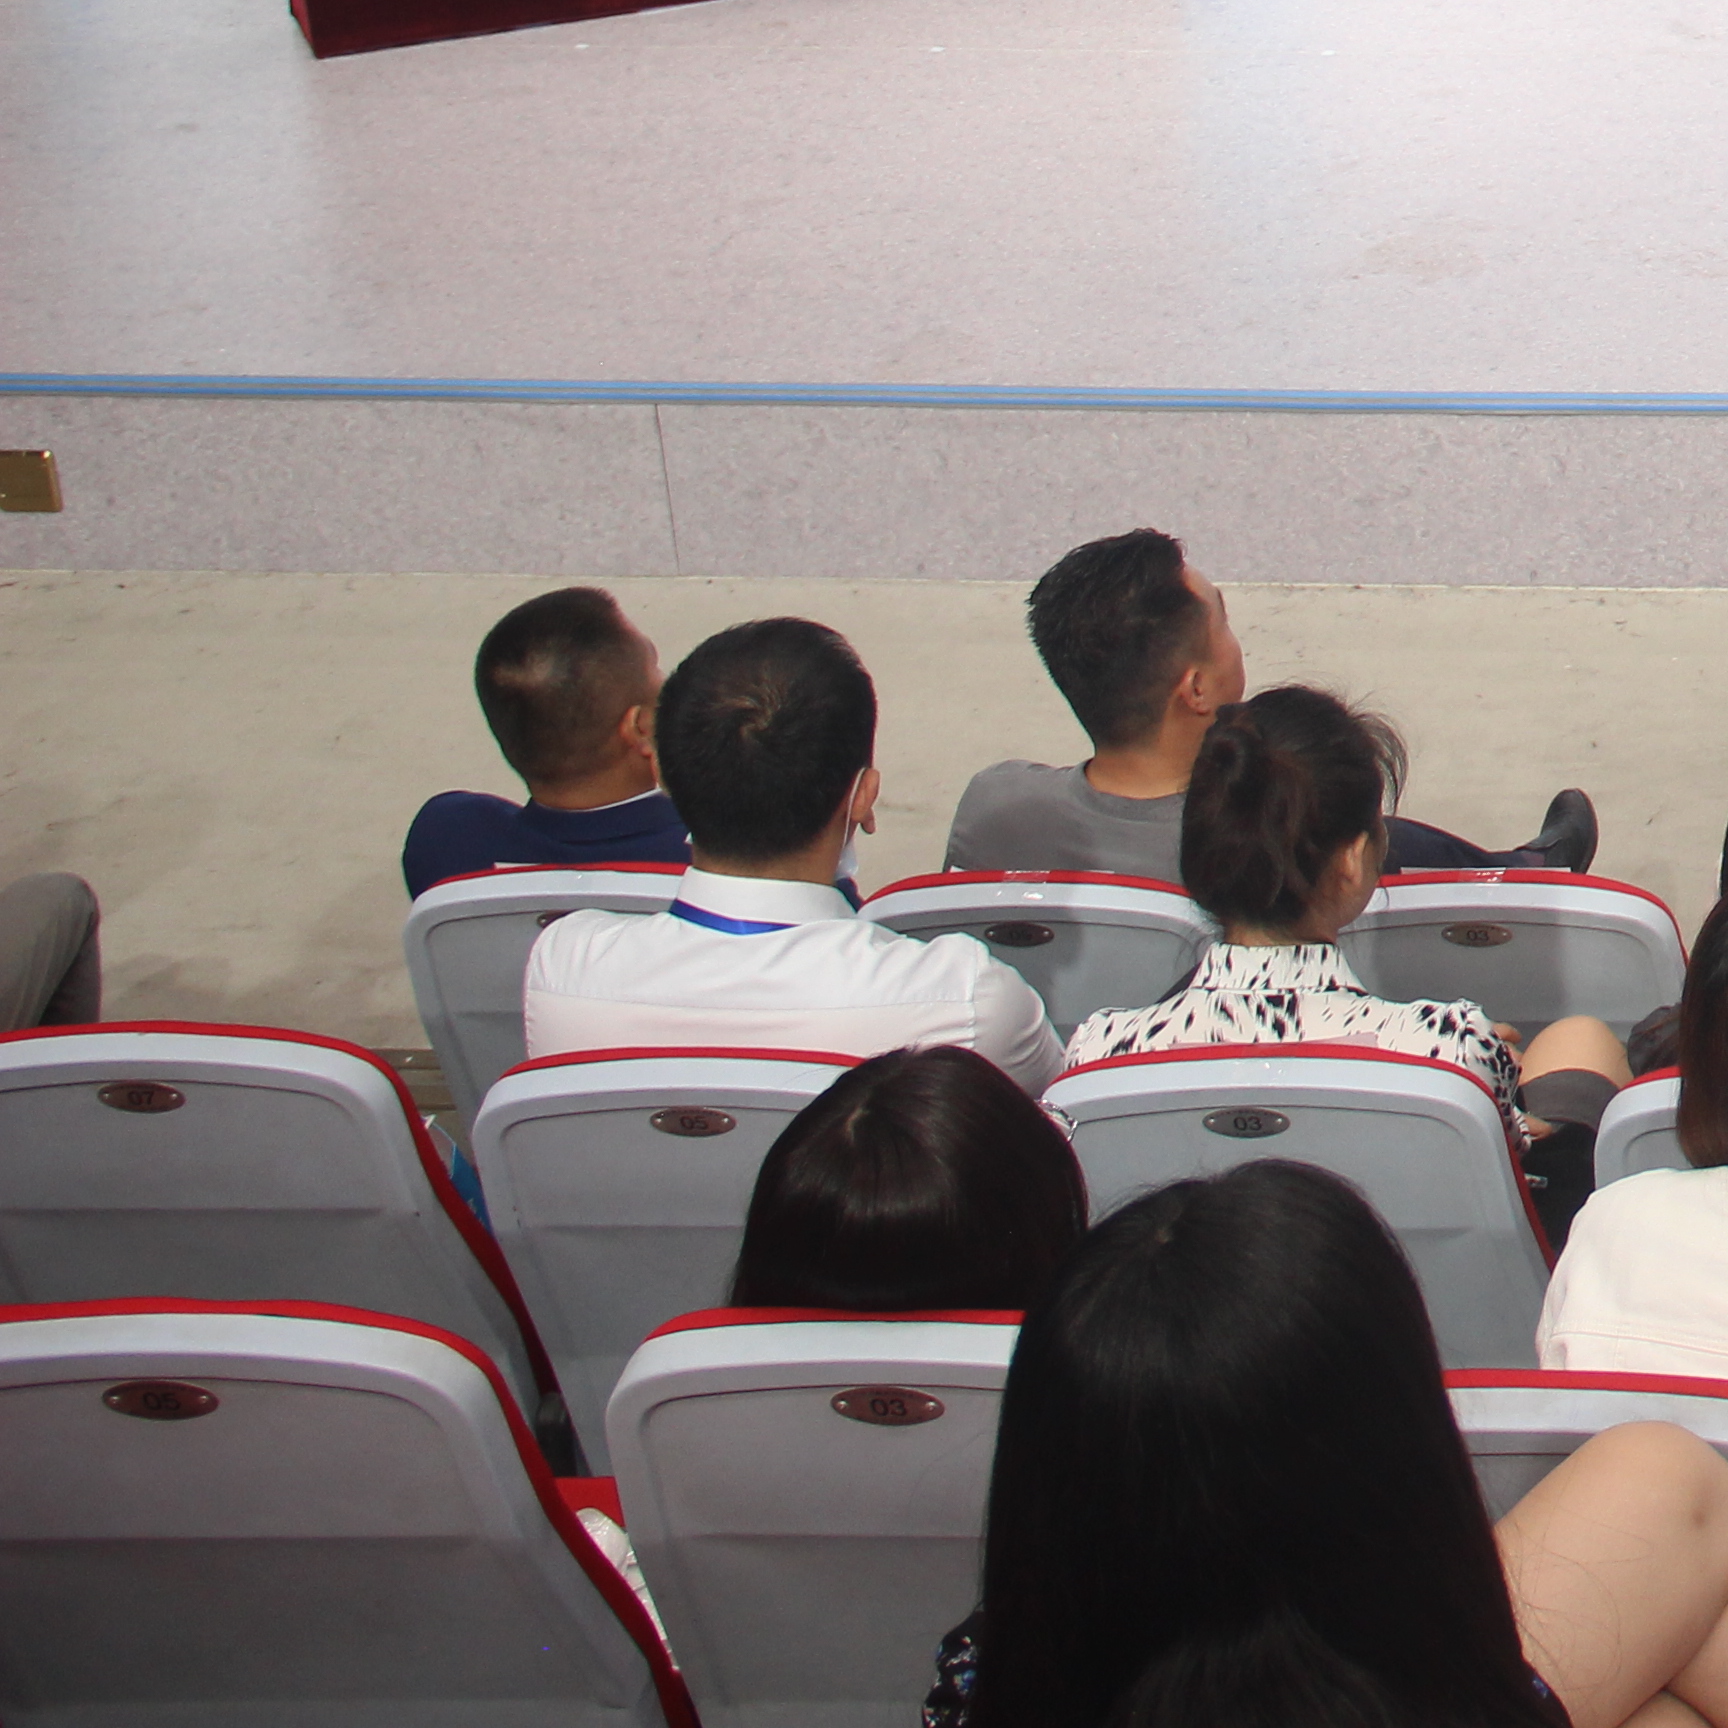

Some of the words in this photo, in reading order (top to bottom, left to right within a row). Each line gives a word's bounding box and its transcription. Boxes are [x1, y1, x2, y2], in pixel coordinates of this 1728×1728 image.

[1466, 929, 1490, 941] 03
[127, 1089, 156, 1105] 07
[679, 1115, 709, 1130] 05
[1232, 1114, 1263, 1131] 03
[869, 1397, 908, 1417] 03
